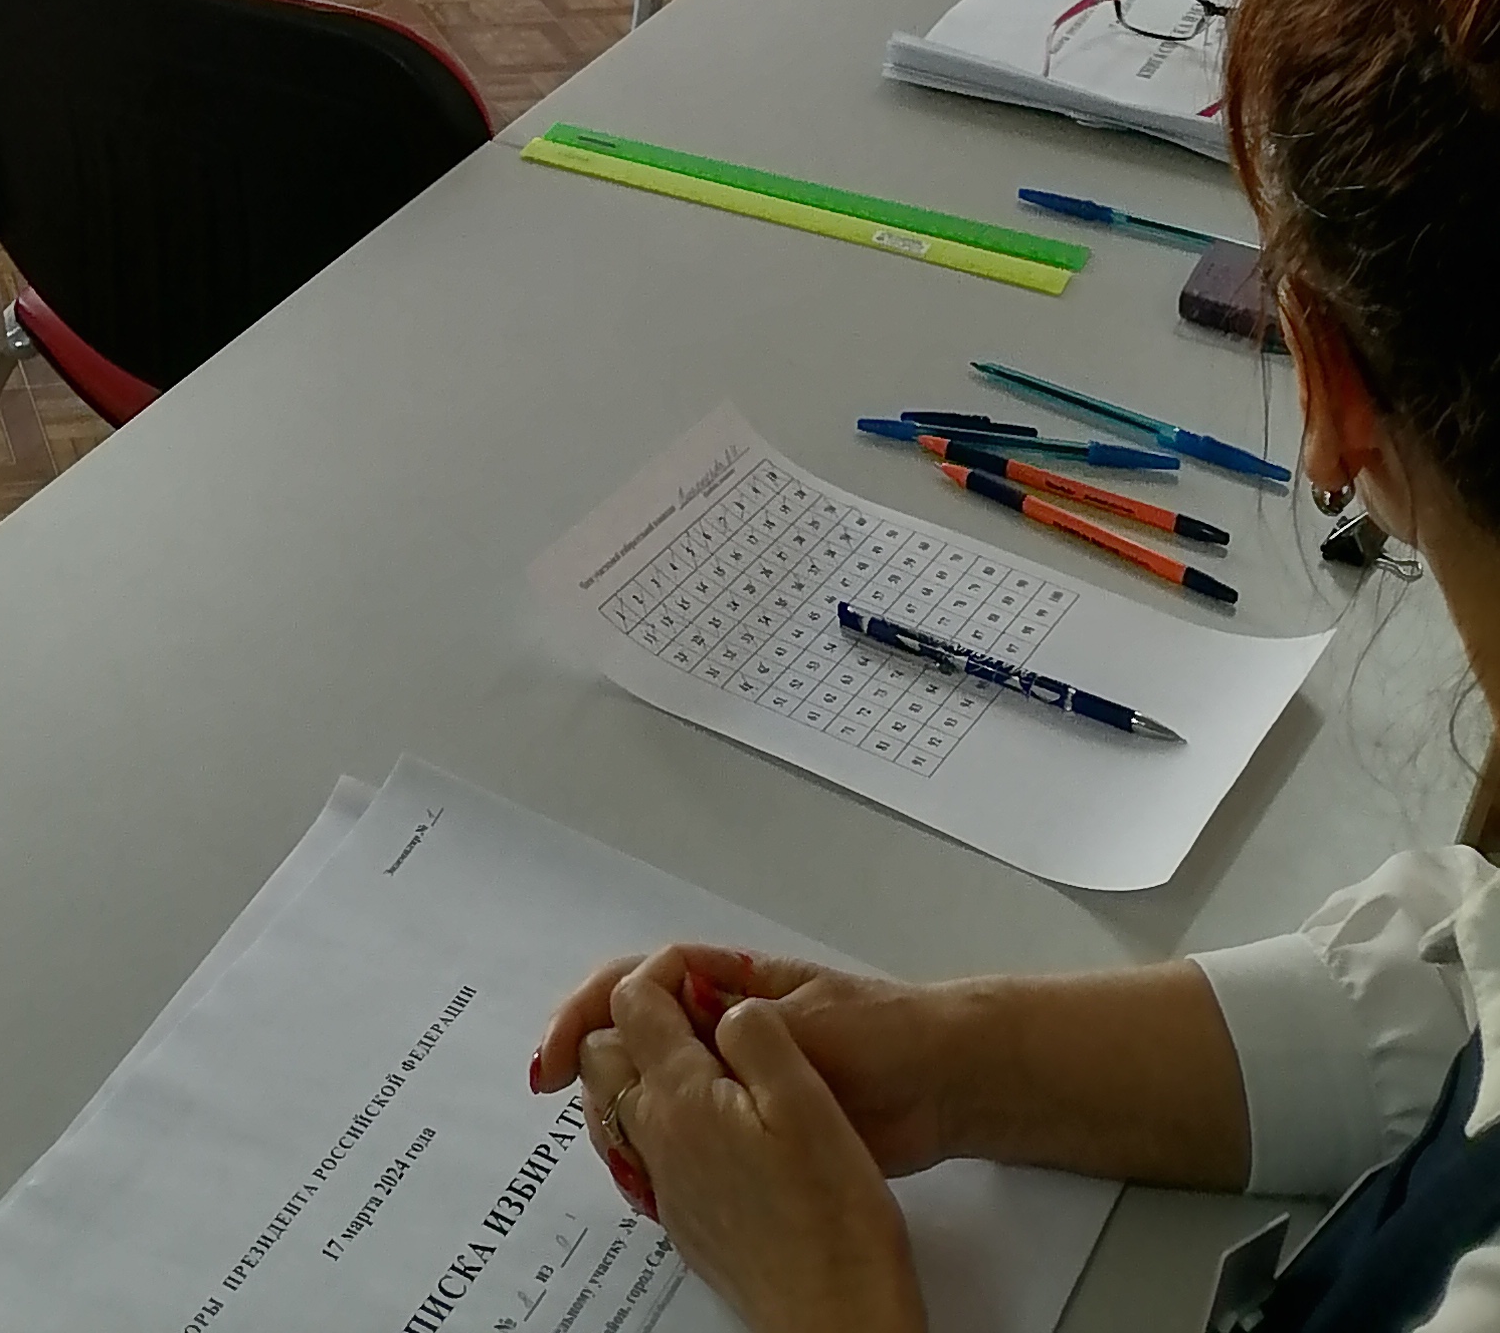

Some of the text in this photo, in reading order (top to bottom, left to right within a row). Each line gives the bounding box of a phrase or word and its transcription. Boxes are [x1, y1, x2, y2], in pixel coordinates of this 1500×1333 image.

[222, 1183, 319, 1291] ПРЕЗИДЕНТА
[312, 1073, 406, 1181] РОССИЙСКОЙ
[401, 985, 477, 1072] ФЕДЕРАЦИИ
[322, 1127, 436, 1261] 17 марта 2024 года
[481, 1095, 586, 1237] ИЗБИРАТЕ
[535, 1264, 554, 1283] из
